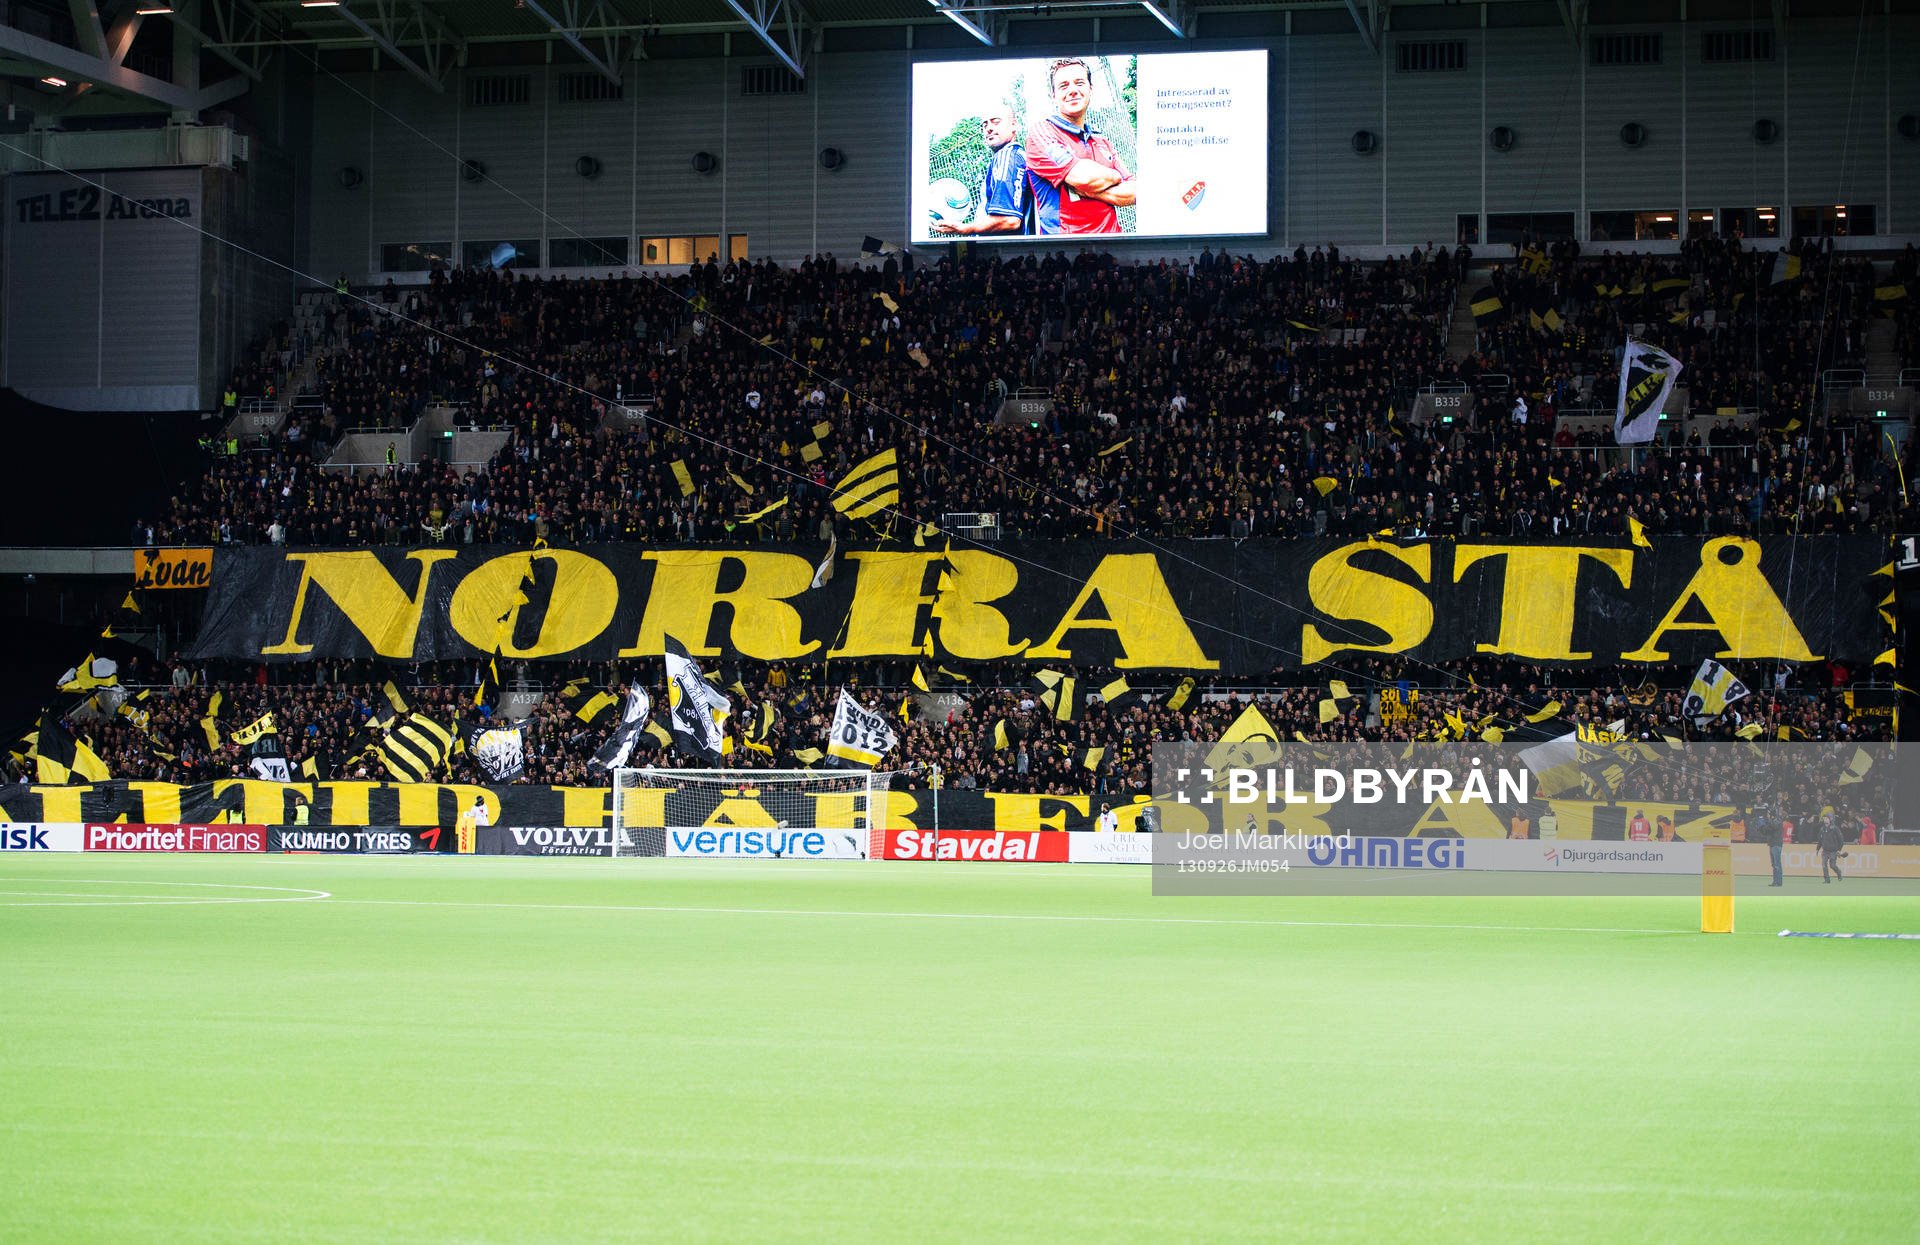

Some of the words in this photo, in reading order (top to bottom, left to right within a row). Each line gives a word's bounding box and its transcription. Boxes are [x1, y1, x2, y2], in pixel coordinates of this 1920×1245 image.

[1157, 87, 1215, 97] Intresserad
[1156, 125, 1204, 134] Kontakta
[17, 185, 101, 223] TELE2
[105, 194, 192, 219] Arena
[1435, 397, 1461, 407] B335
[1869, 391, 1895, 401] B334
[1021, 403, 1045, 413] B336
[253, 416, 276, 425] B338
[135, 549, 211, 588] Ivan
[261, 548, 1220, 671] NORRA
[1301, 535, 1825, 664] STÅ
[512, 694, 537, 704] A137
[937, 695, 964, 705] A136
[832, 721, 888, 755] 2012
[90, 827, 185, 850] Prioritet
[189, 828, 260, 851] Finans
[281, 832, 350, 849] KUMHO
[353, 833, 411, 850] TYRES
[509, 827, 635, 846] VOLVIA
[672, 831, 825, 855] verisure
[541, 846, 602, 856] Försäkring
[894, 830, 1040, 861] Stavdal
[1563, 849, 1664, 865] Djurgårdsandan
